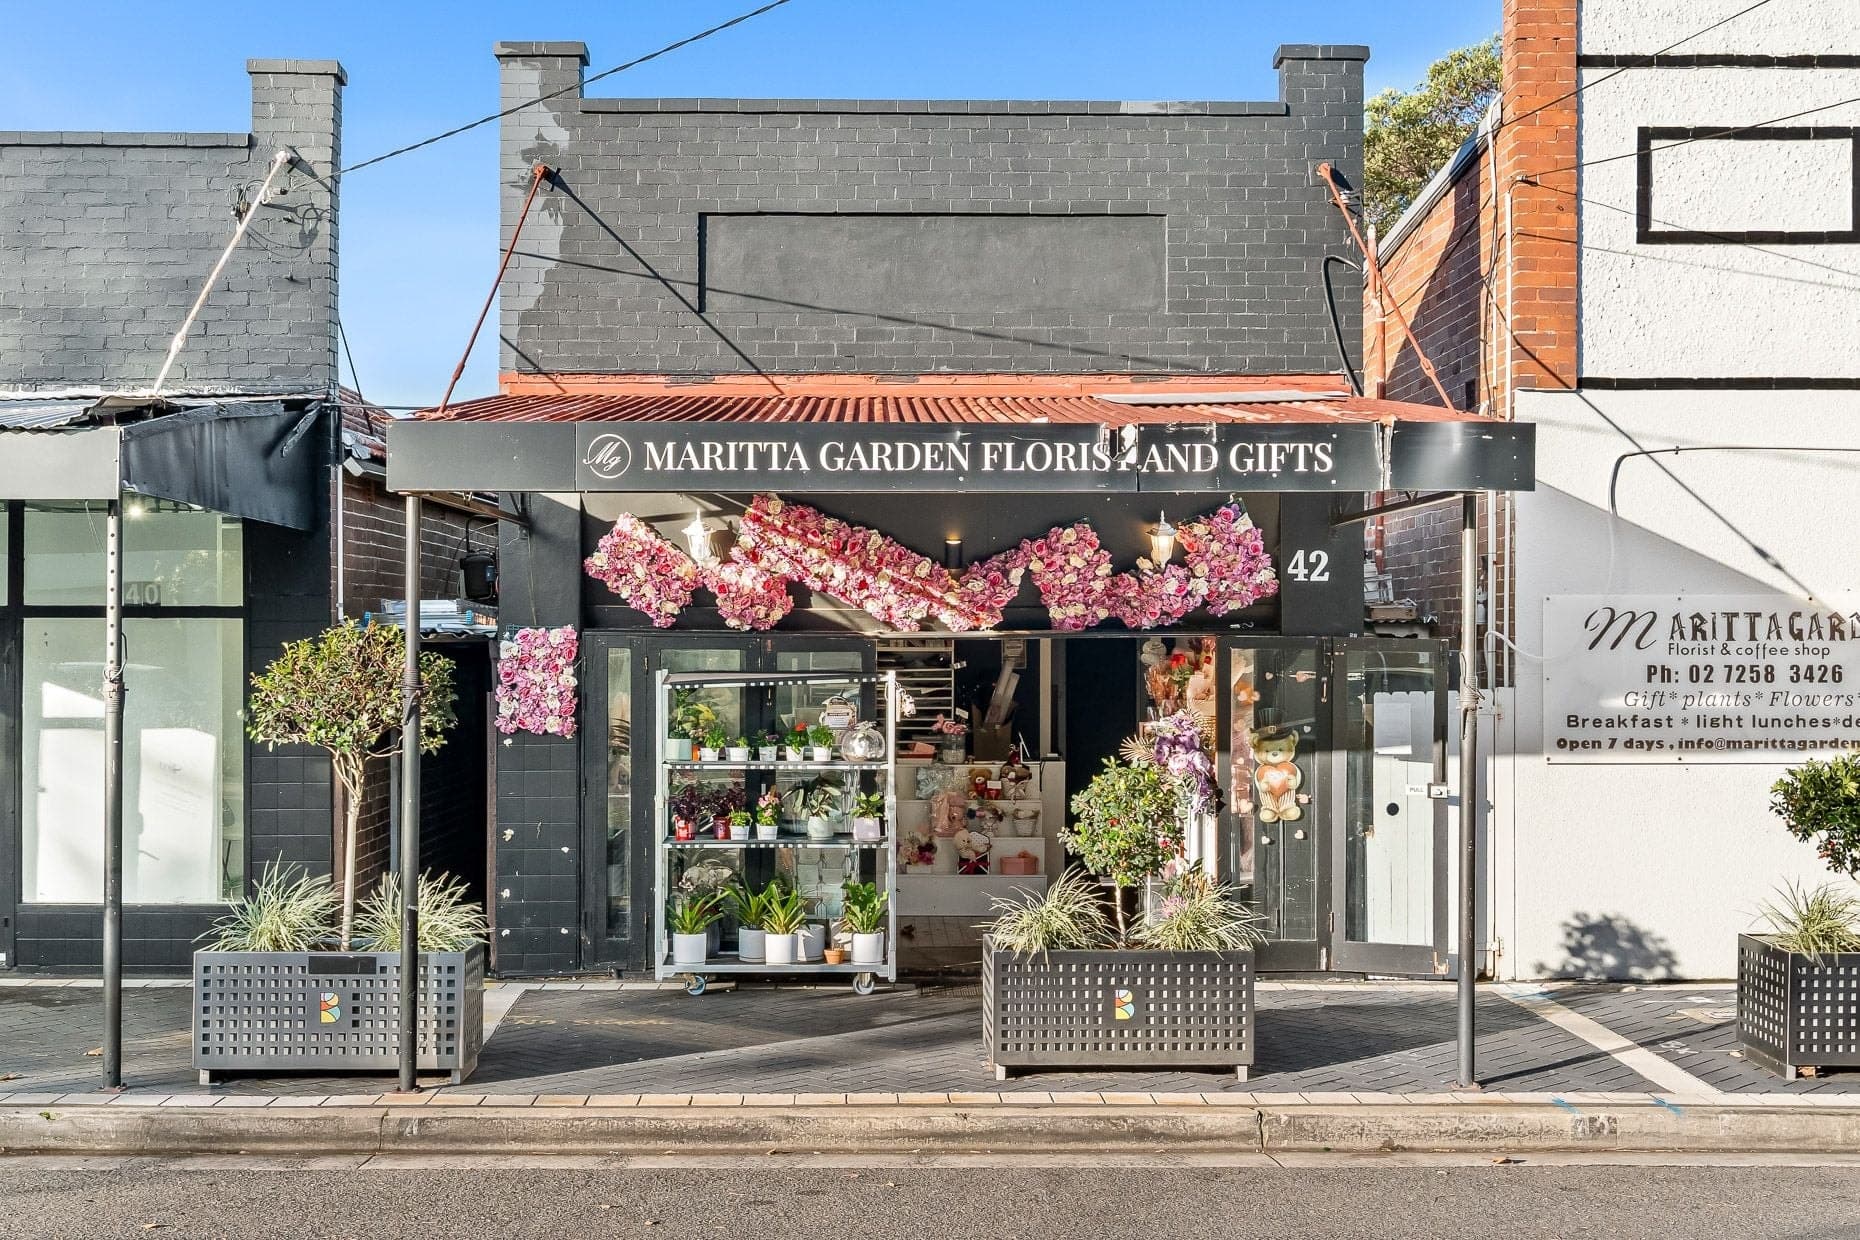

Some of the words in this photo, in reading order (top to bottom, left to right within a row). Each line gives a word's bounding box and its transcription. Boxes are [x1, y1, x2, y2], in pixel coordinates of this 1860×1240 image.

[643, 441, 810, 471] MARITTA
[819, 441, 971, 472] GARDEN
[1141, 443, 1219, 473] AND
[1229, 442, 1333, 473] GIFTS
[1287, 549, 1330, 582] 42
[126, 584, 159, 605] 40
[1668, 643, 1715, 656] Florist
[1720, 643, 1731, 656] &
[1735, 643, 1789, 660] coffee
[1794, 643, 1831, 660] shop
[1646, 664, 1679, 684] Ph:
[1689, 664, 1714, 684] 02
[1724, 664, 1775, 684] 7258
[1789, 664, 1843, 684] 3426
[1566, 714, 1673, 729] Breakfast
[1696, 714, 1743, 729] light
[1556, 737, 1602, 752] Open
[1608, 737, 1618, 750] 7
